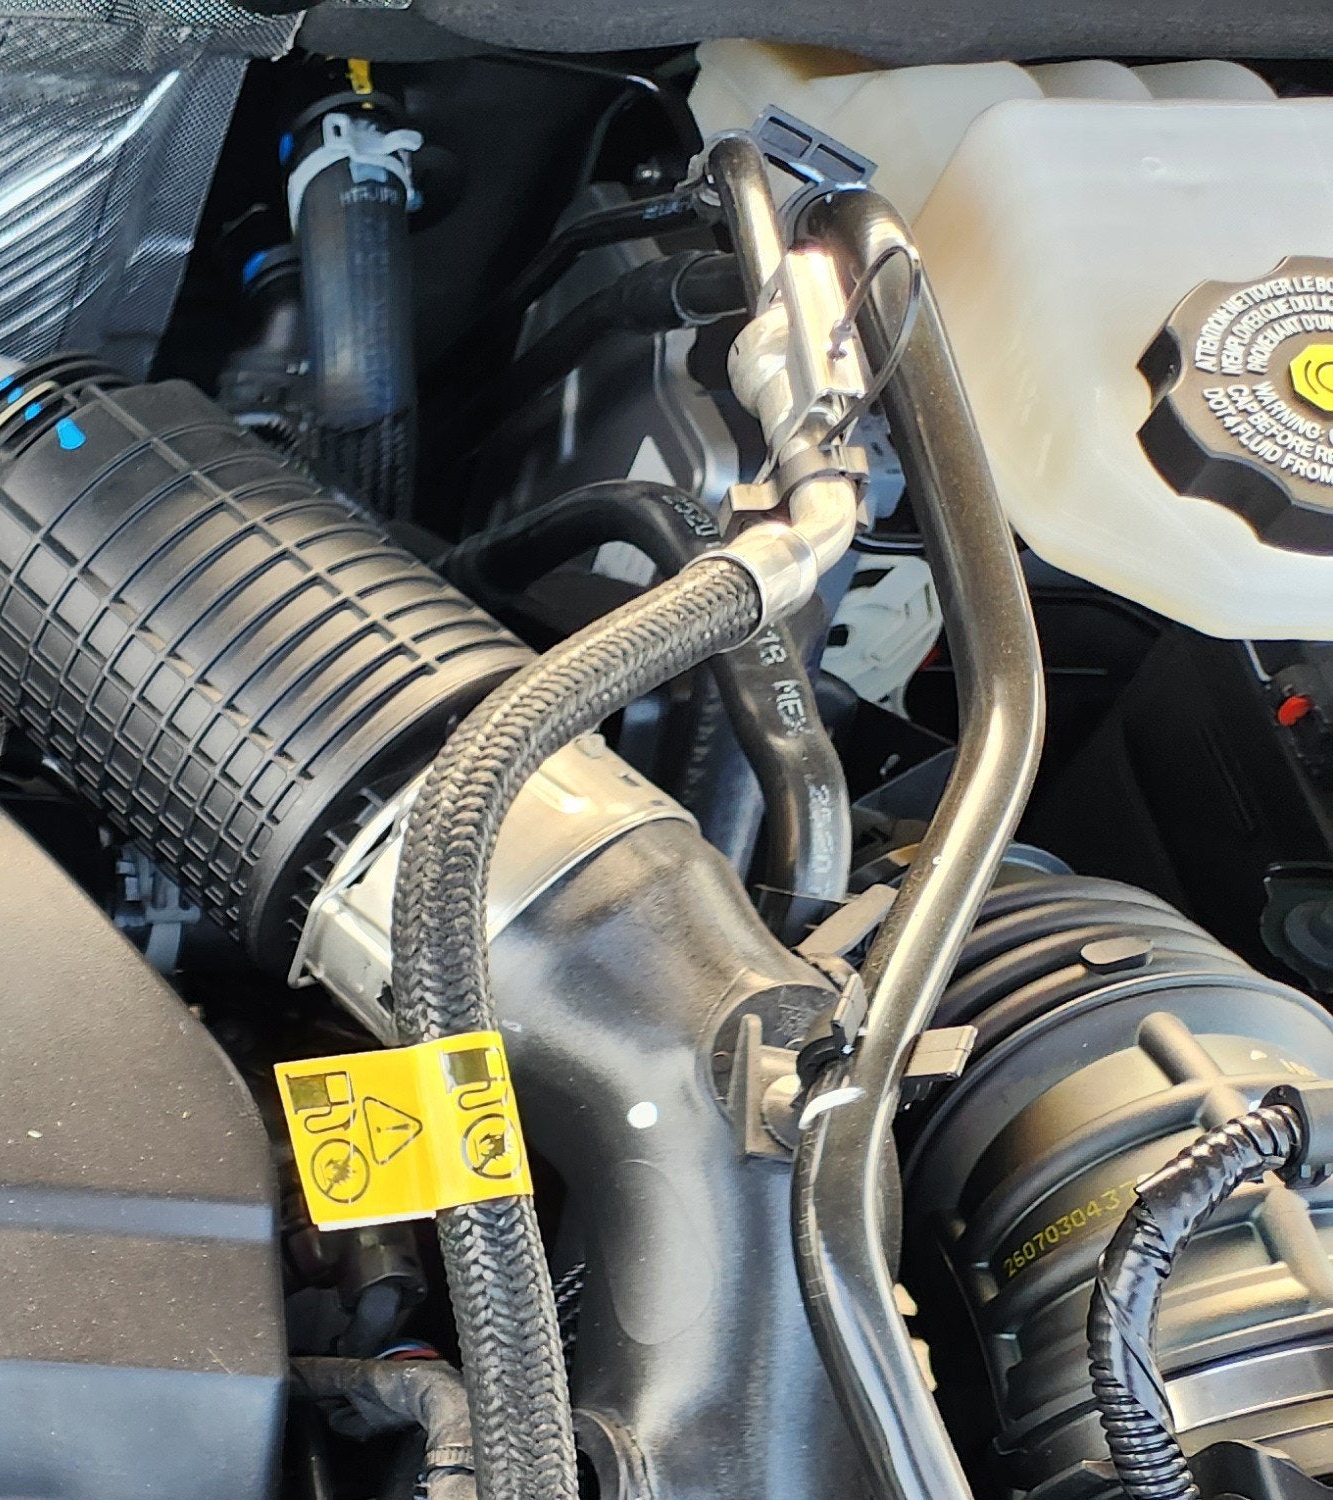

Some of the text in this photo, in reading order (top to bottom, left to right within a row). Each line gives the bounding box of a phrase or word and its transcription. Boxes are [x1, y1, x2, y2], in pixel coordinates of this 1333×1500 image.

[1202, 387, 1238, 418] DOT
[1230, 422, 1283, 462] FLUID
[1227, 384, 1262, 413] CAP
[1248, 410, 1317, 458] BEFORE
